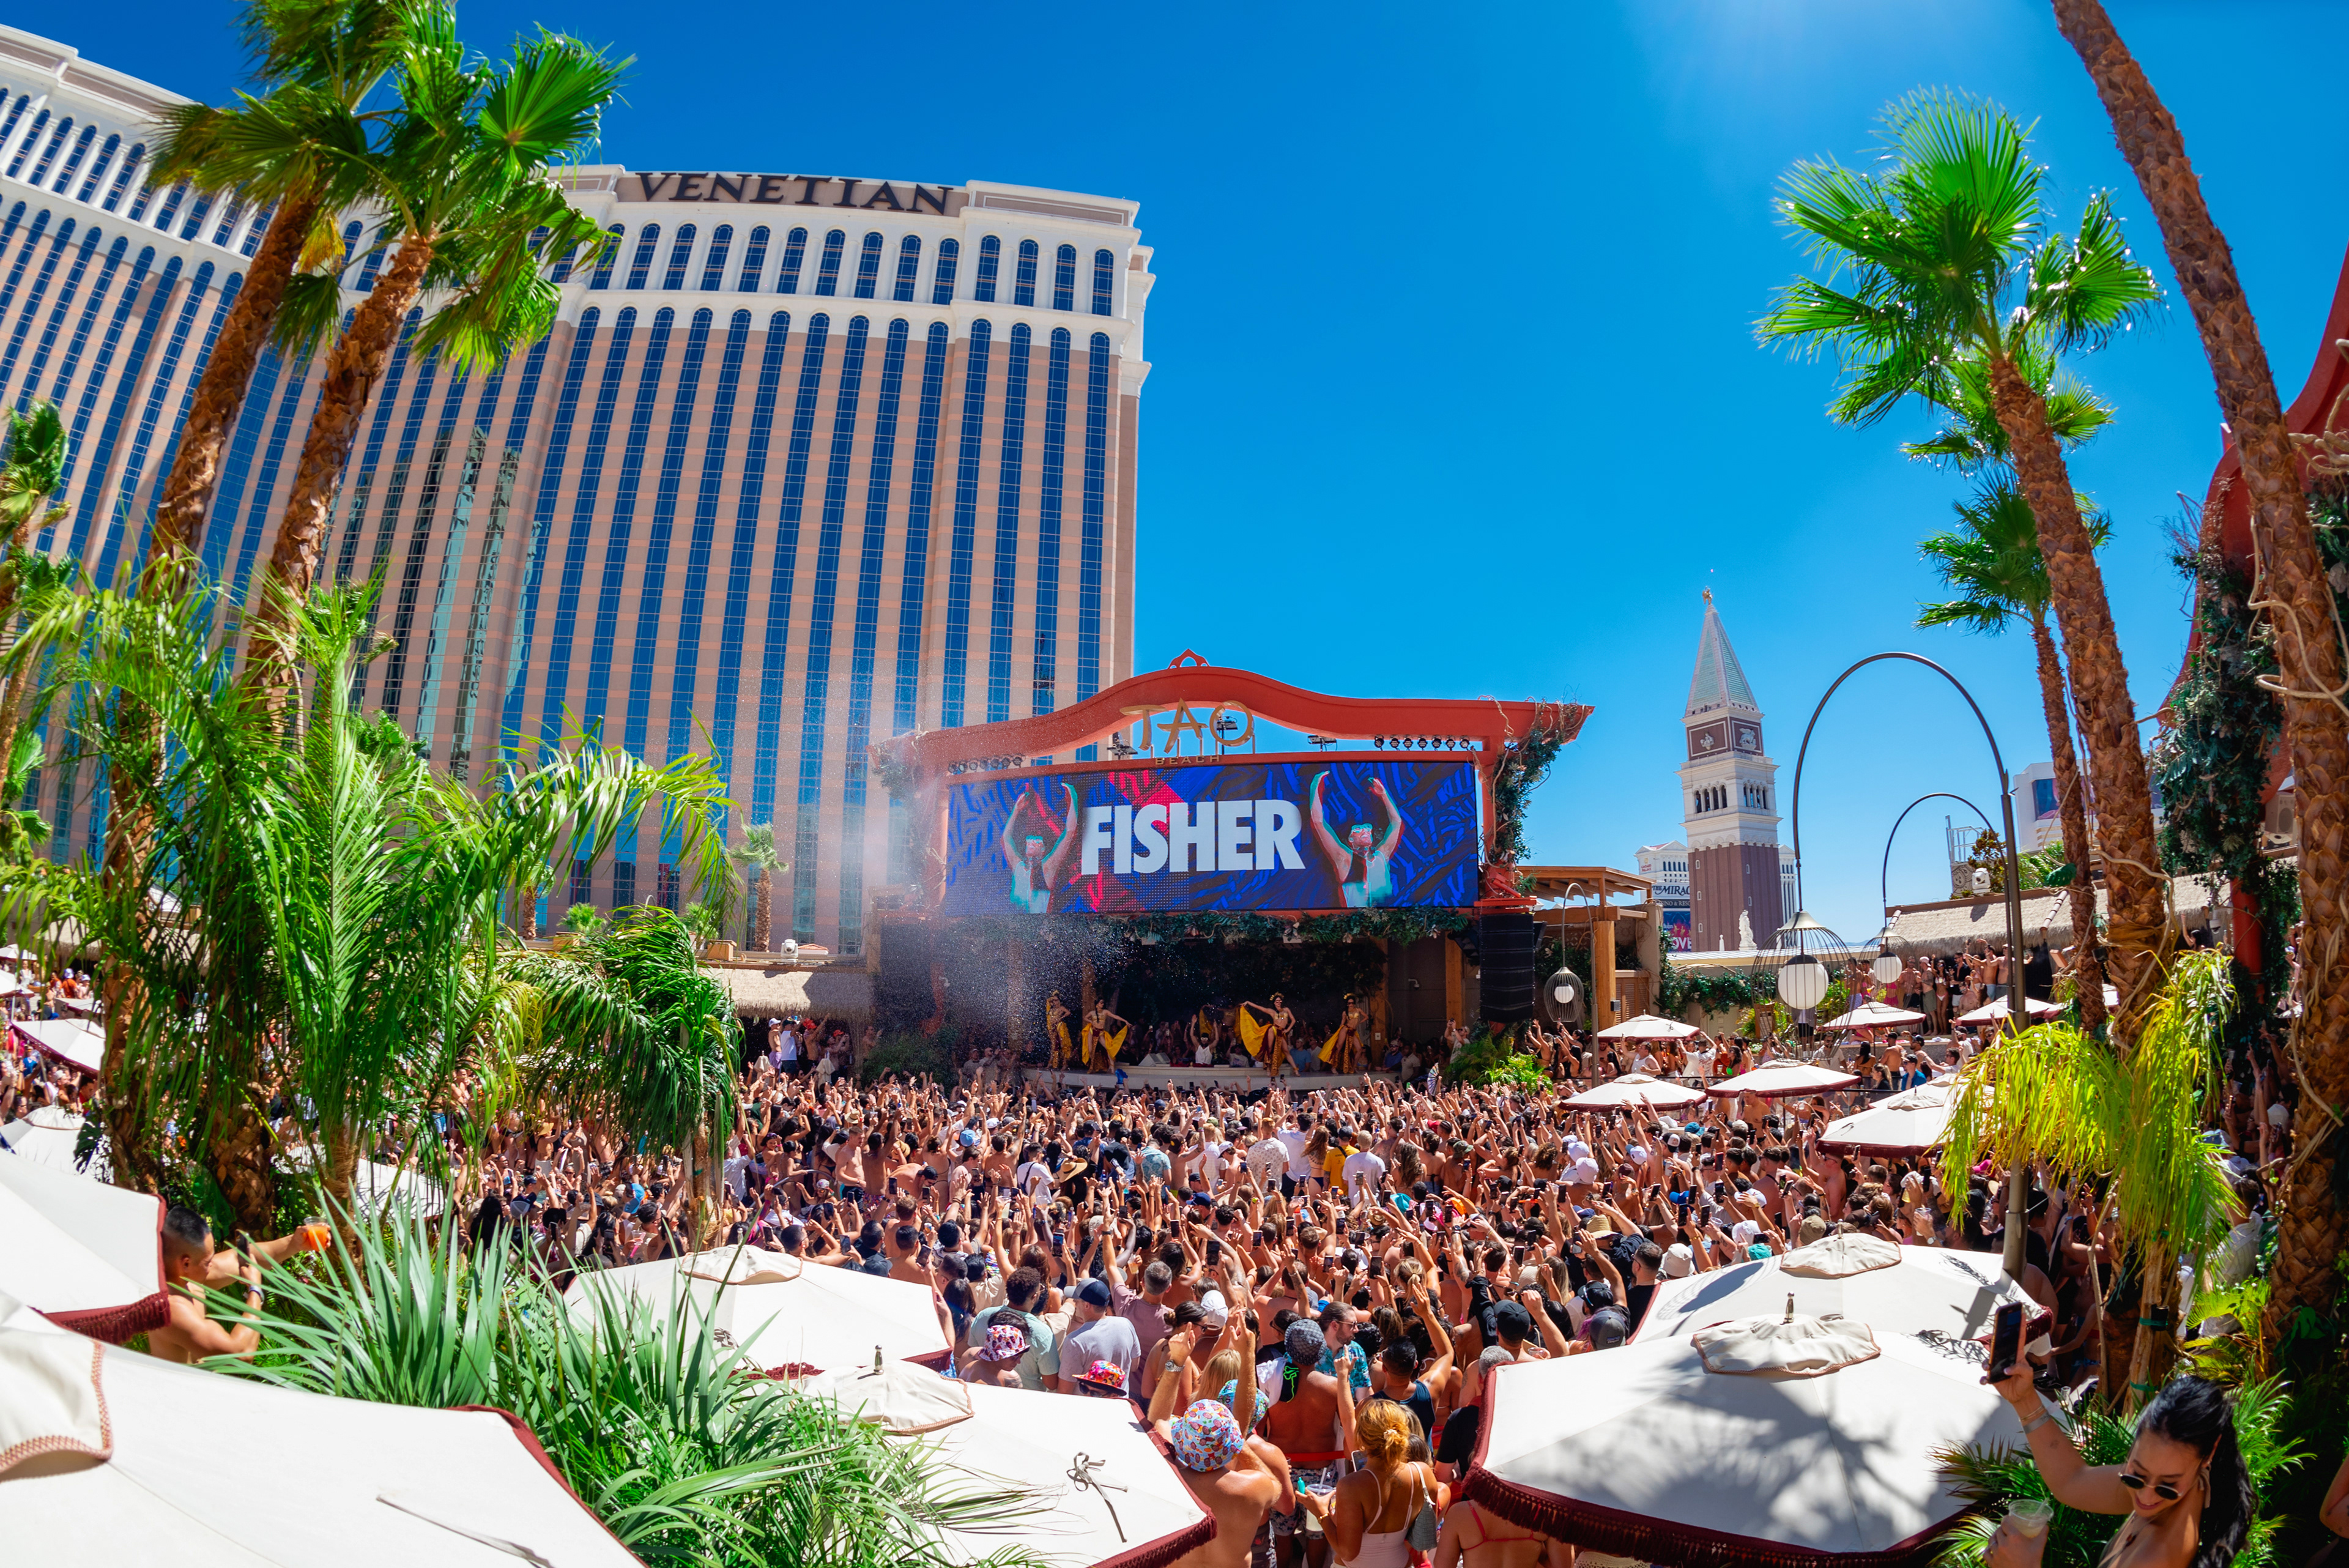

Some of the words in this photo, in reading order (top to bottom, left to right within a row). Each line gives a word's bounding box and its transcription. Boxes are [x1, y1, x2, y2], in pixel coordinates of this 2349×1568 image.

[634, 171, 954, 215] VENETIAN
[1119, 697, 1254, 754] TAO
[1155, 754, 1220, 765] BEACH
[1081, 799, 1307, 875] FISHER
[1670, 937, 1692, 949] OVE
